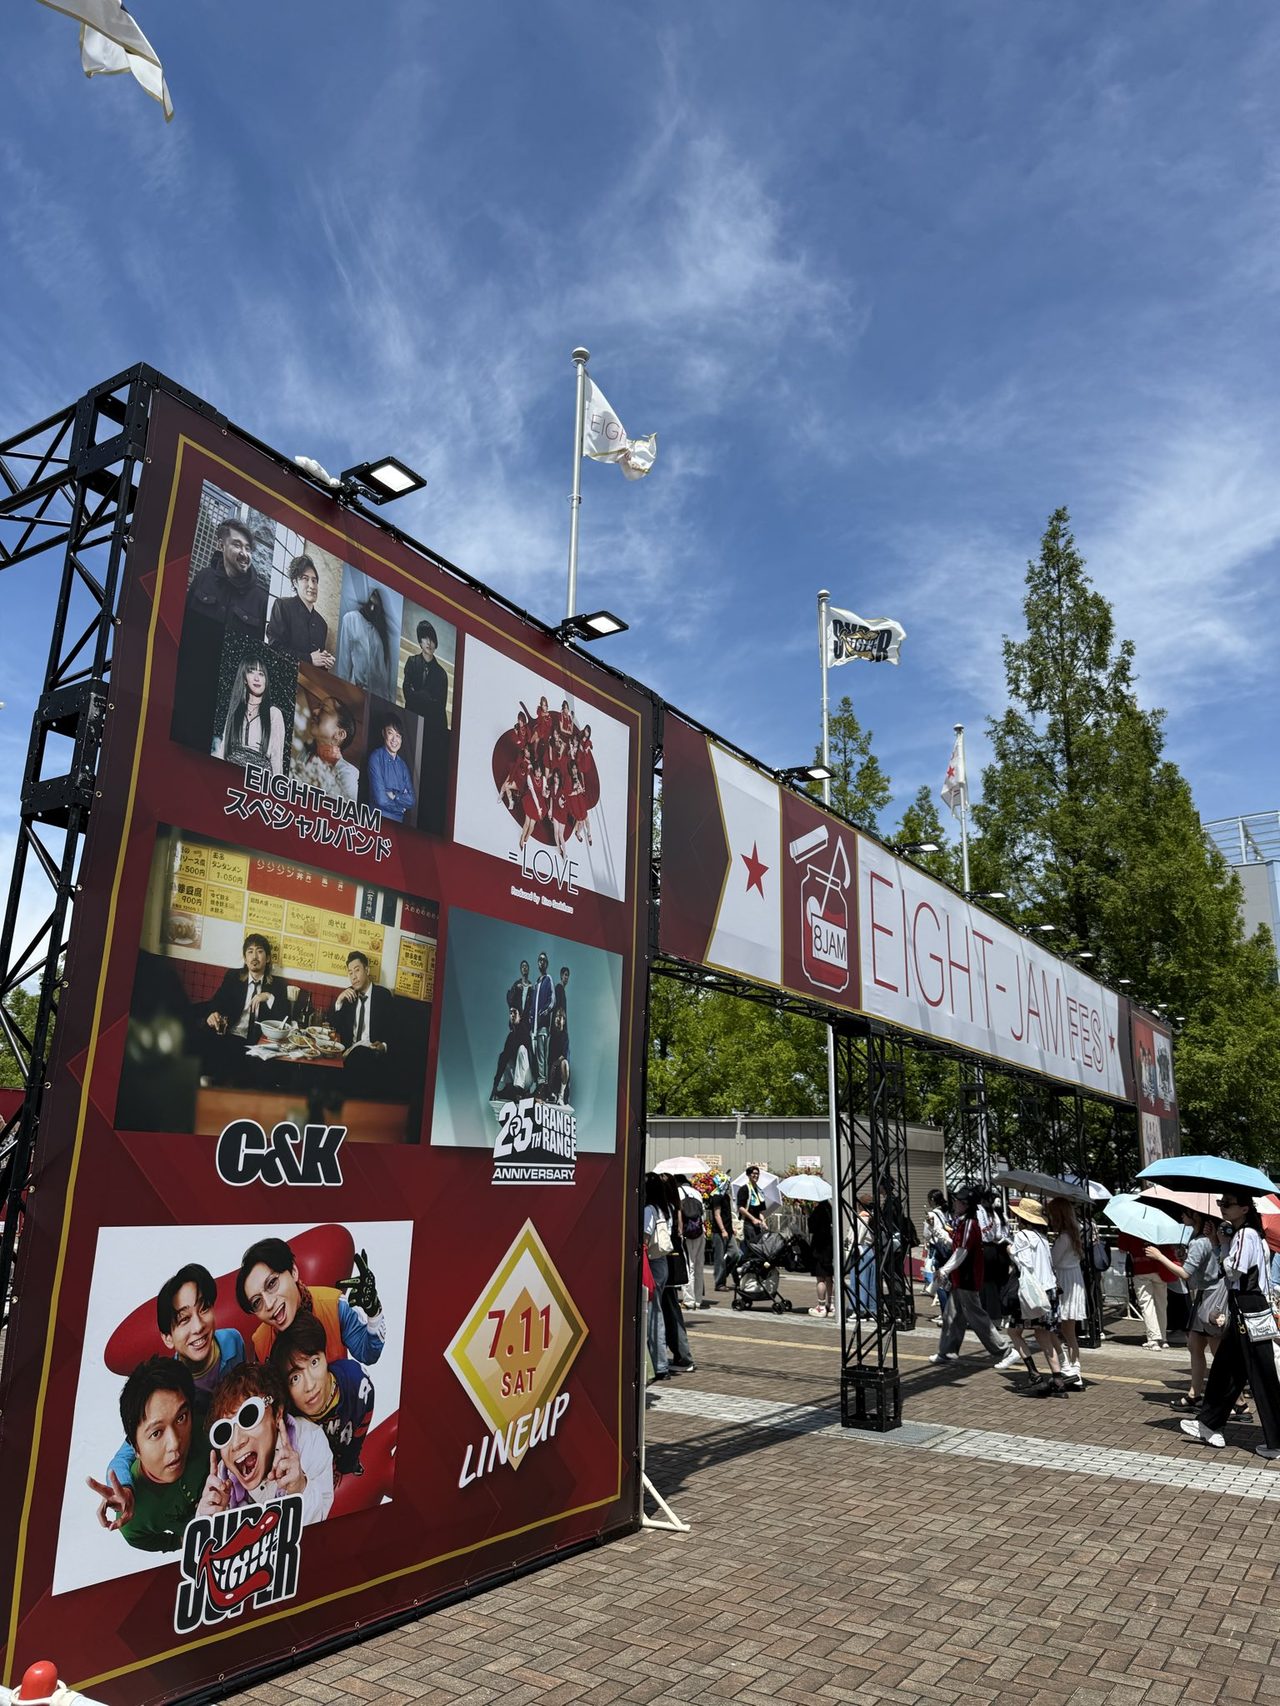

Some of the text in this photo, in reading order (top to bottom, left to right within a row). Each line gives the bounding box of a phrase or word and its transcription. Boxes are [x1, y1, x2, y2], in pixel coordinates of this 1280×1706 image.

[224, 787, 392, 862] スペシャルバンド
[244, 762, 382, 833] EIGHT-JAM
[813, 925, 847, 962] 8JAM
[534, 1103, 577, 1139] ORANGE
[542, 1127, 577, 1161] RANGE
[215, 1118, 348, 1187] C&K
[492, 1168, 575, 1180] ANNIVERSARY
[487, 1304, 551, 1360] 7.11
[501, 1367, 536, 1398] SAT
[458, 1392, 570, 1489] LINEUP
[174, 1493, 304, 1635] SUR
